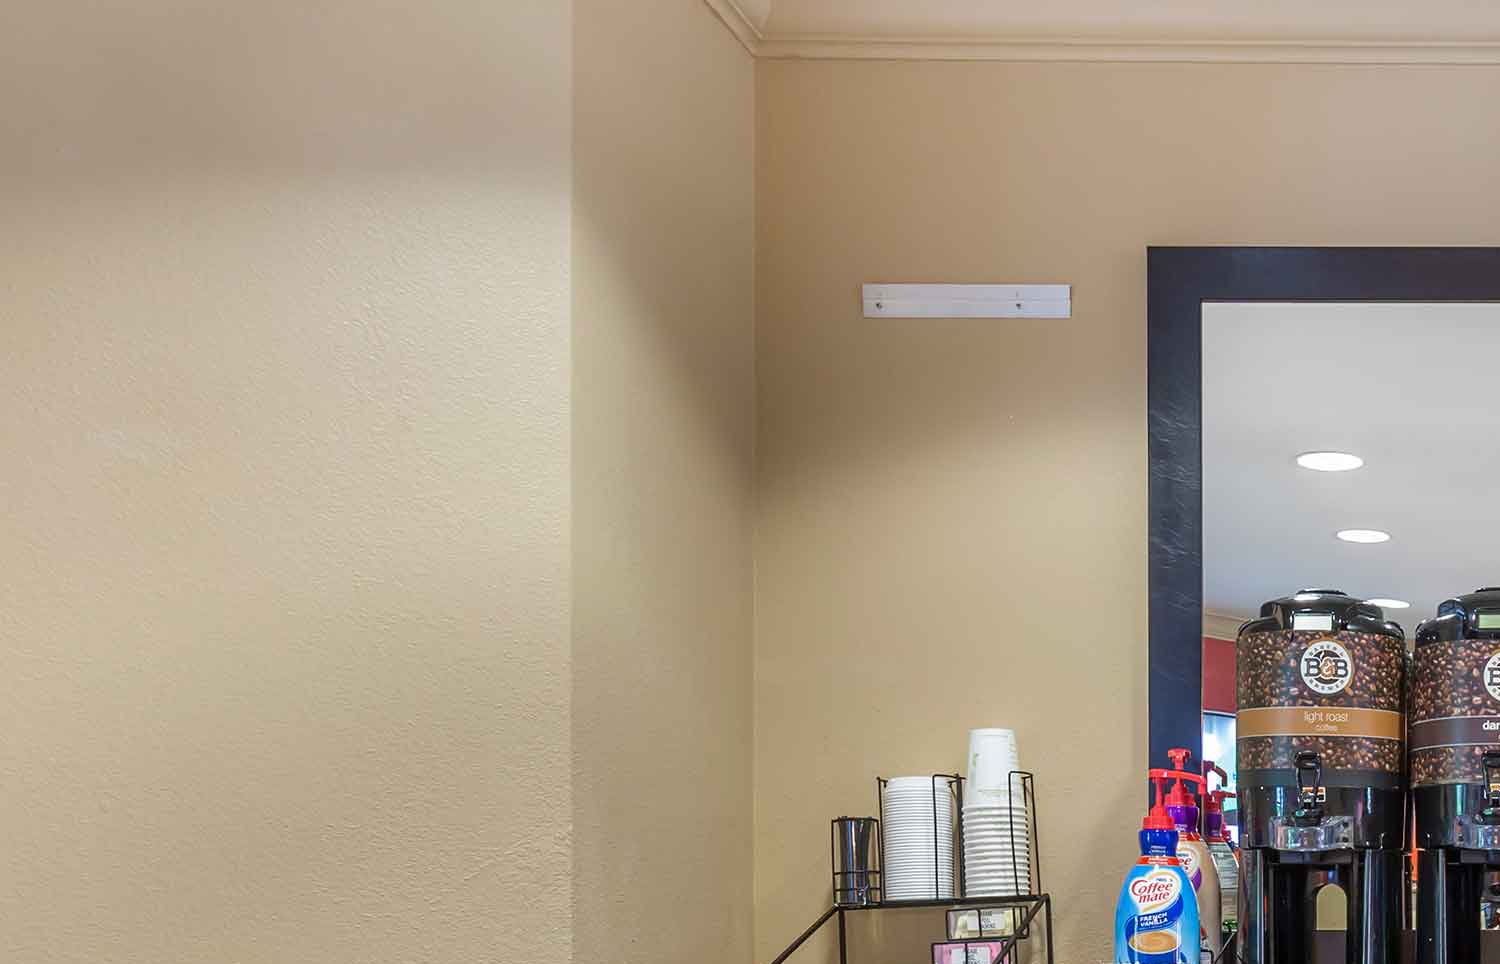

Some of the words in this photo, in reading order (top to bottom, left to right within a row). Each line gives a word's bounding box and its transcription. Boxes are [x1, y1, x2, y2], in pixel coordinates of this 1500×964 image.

[1304, 657, 1349, 679] B&B
[1304, 711, 1323, 723] light
[1326, 712, 1349, 721] roast
[1131, 879, 1173, 897] Coffee
[1139, 891, 1170, 903] mate
[1140, 912, 1168, 921] FRENCH
[1140, 917, 1168, 927] VANILLA
